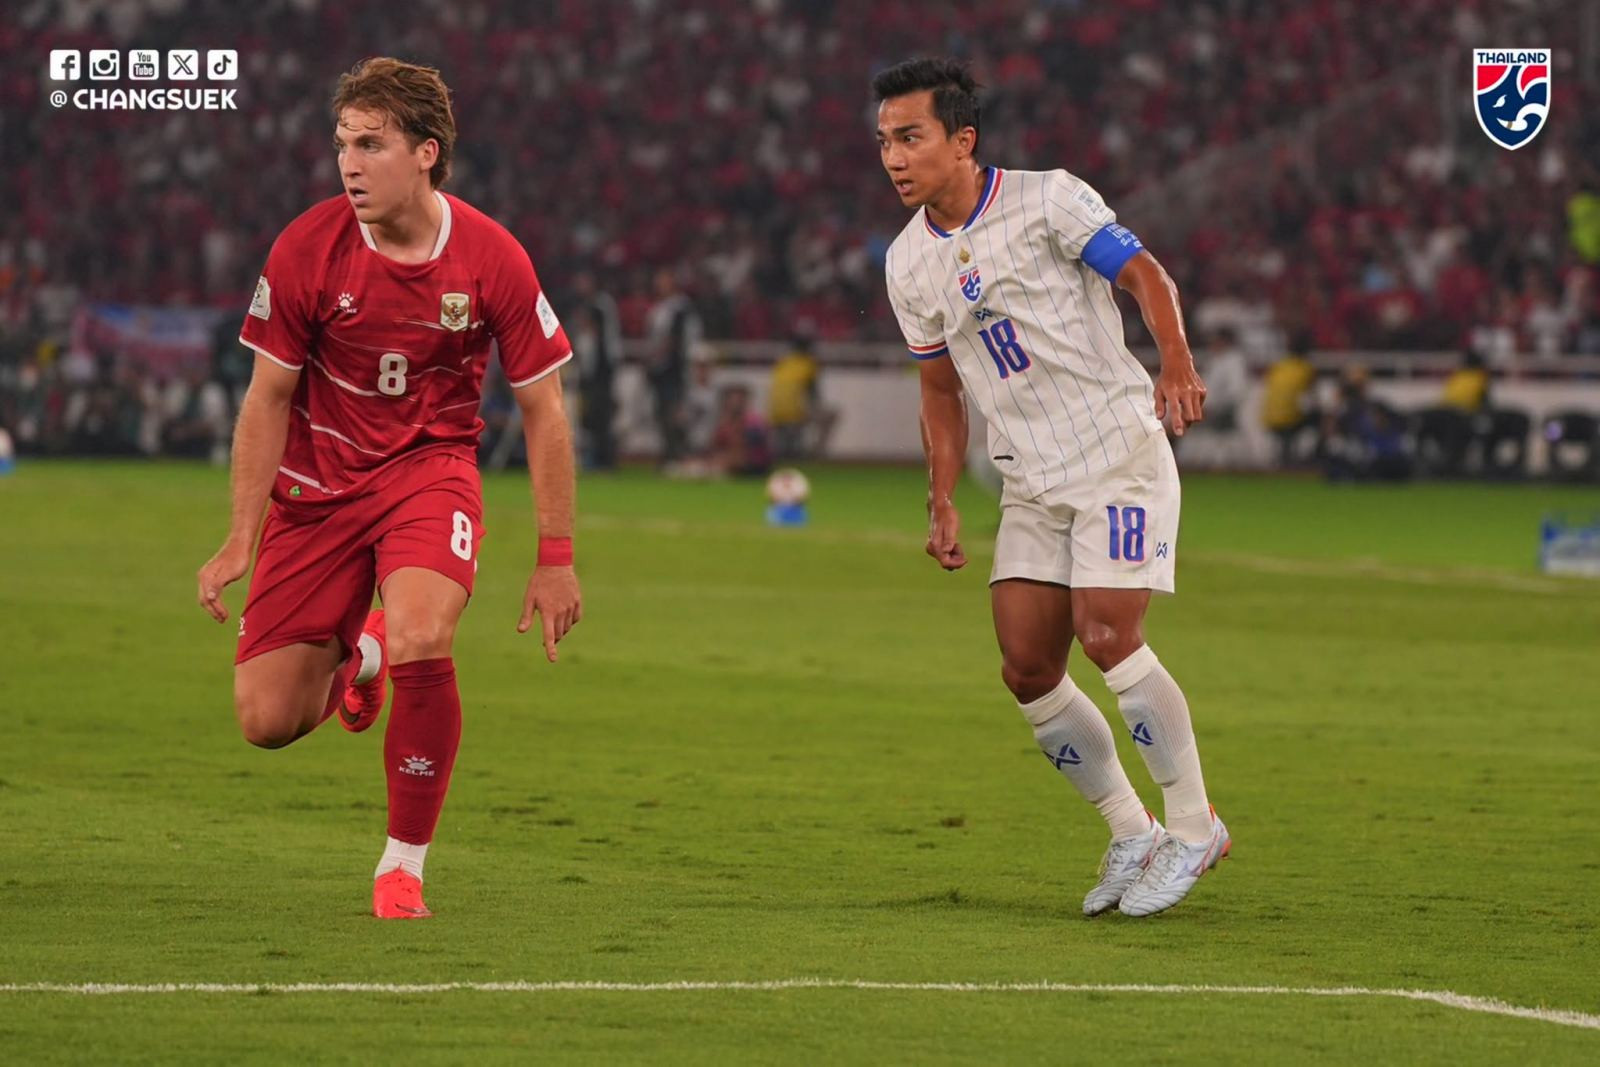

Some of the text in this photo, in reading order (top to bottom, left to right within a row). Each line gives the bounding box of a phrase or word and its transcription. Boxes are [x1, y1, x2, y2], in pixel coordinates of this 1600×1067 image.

[378, 352, 408, 396] 8
[977, 318, 1032, 380] 18
[450, 510, 473, 561] 8
[1105, 505, 1146, 563] 18
[399, 766, 435, 776] KELME
